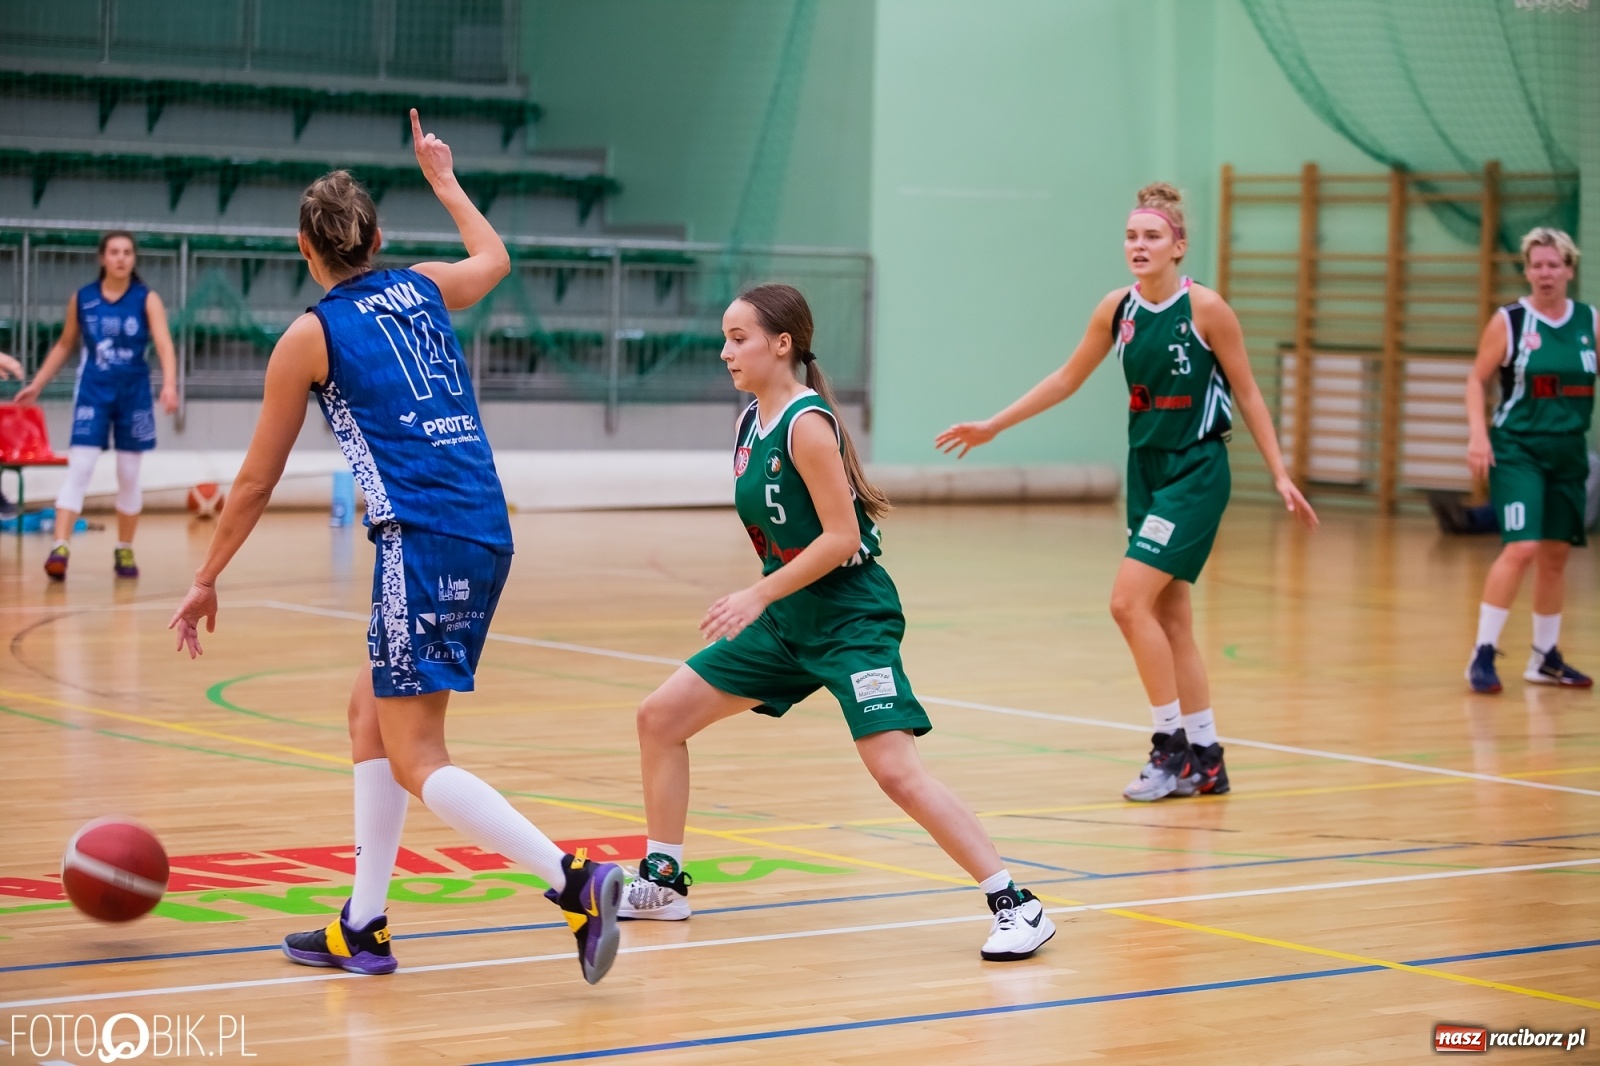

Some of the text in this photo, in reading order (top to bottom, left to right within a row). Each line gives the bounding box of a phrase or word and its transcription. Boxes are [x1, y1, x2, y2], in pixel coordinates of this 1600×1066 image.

[376, 310, 463, 401] 14
[765, 484, 787, 524] 5
[1504, 501, 1526, 531] 10
[863, 702, 893, 713] COLO
